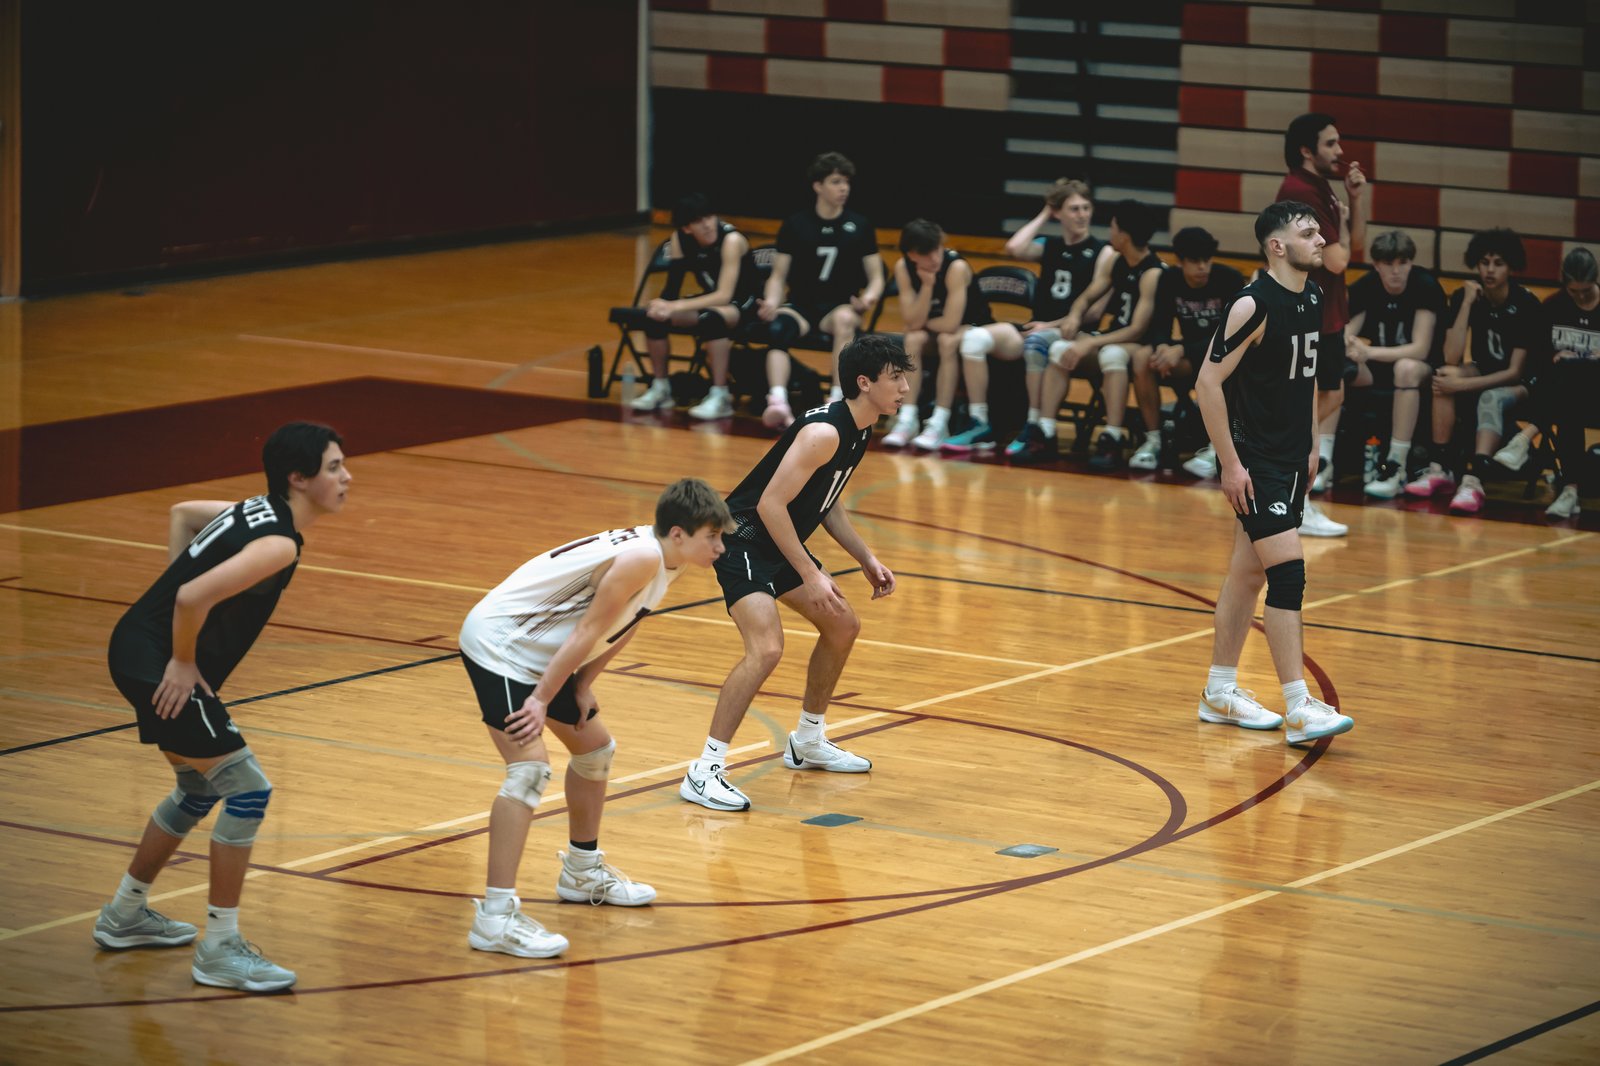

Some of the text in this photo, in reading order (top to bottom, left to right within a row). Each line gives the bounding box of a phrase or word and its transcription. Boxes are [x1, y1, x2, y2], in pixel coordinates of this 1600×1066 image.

[816, 246, 838, 281] 7
[1050, 269, 1072, 300] 8
[1118, 291, 1132, 326] 3
[1289, 331, 1320, 380] 15
[820, 466, 853, 512] 11
